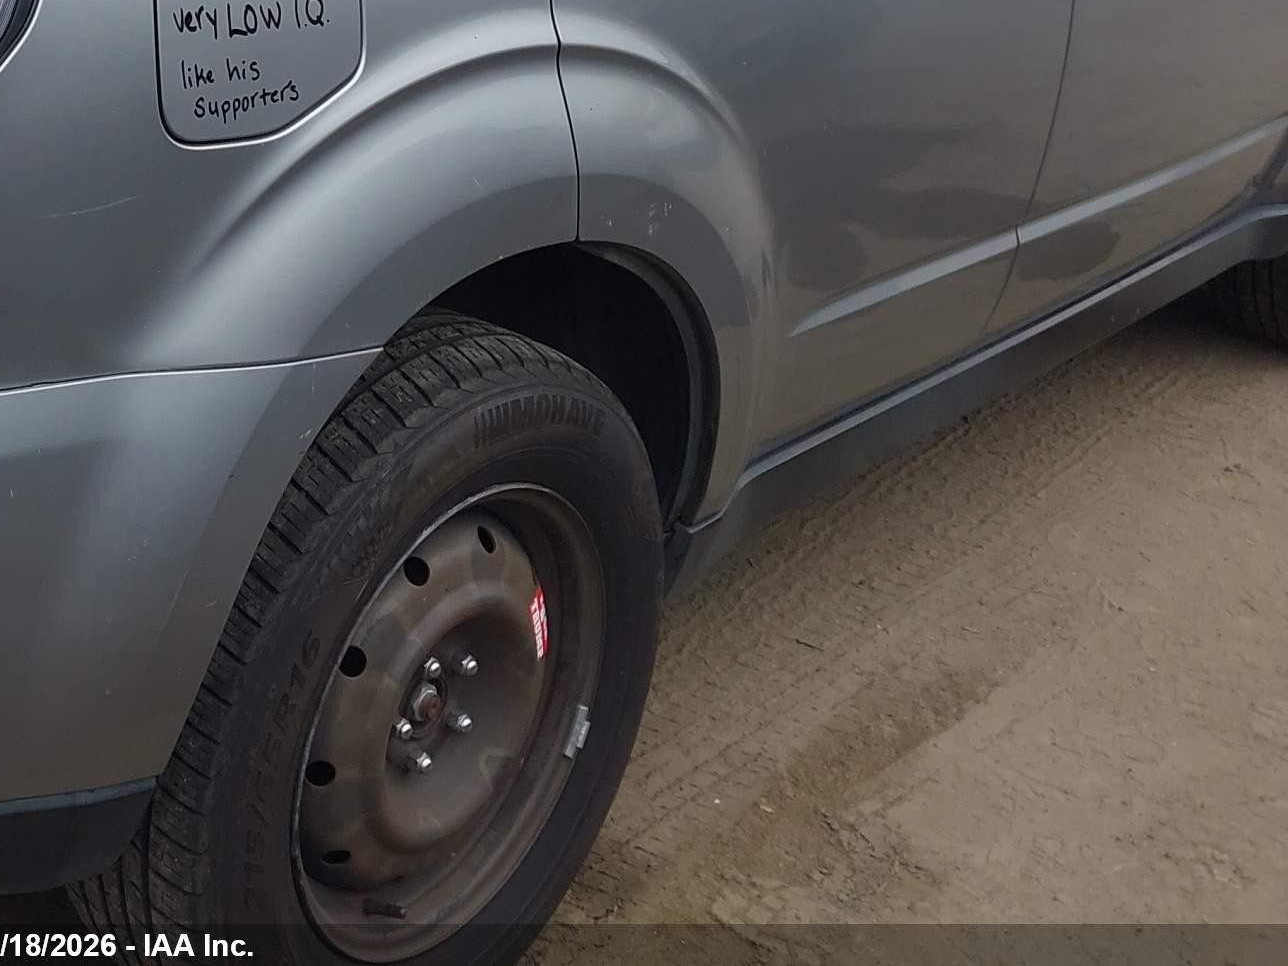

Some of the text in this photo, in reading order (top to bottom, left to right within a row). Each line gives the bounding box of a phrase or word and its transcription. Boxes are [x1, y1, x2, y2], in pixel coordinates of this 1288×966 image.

[173, 5, 218, 40] very
[226, 1, 281, 38] LOW
[181, 58, 261, 89] like his
